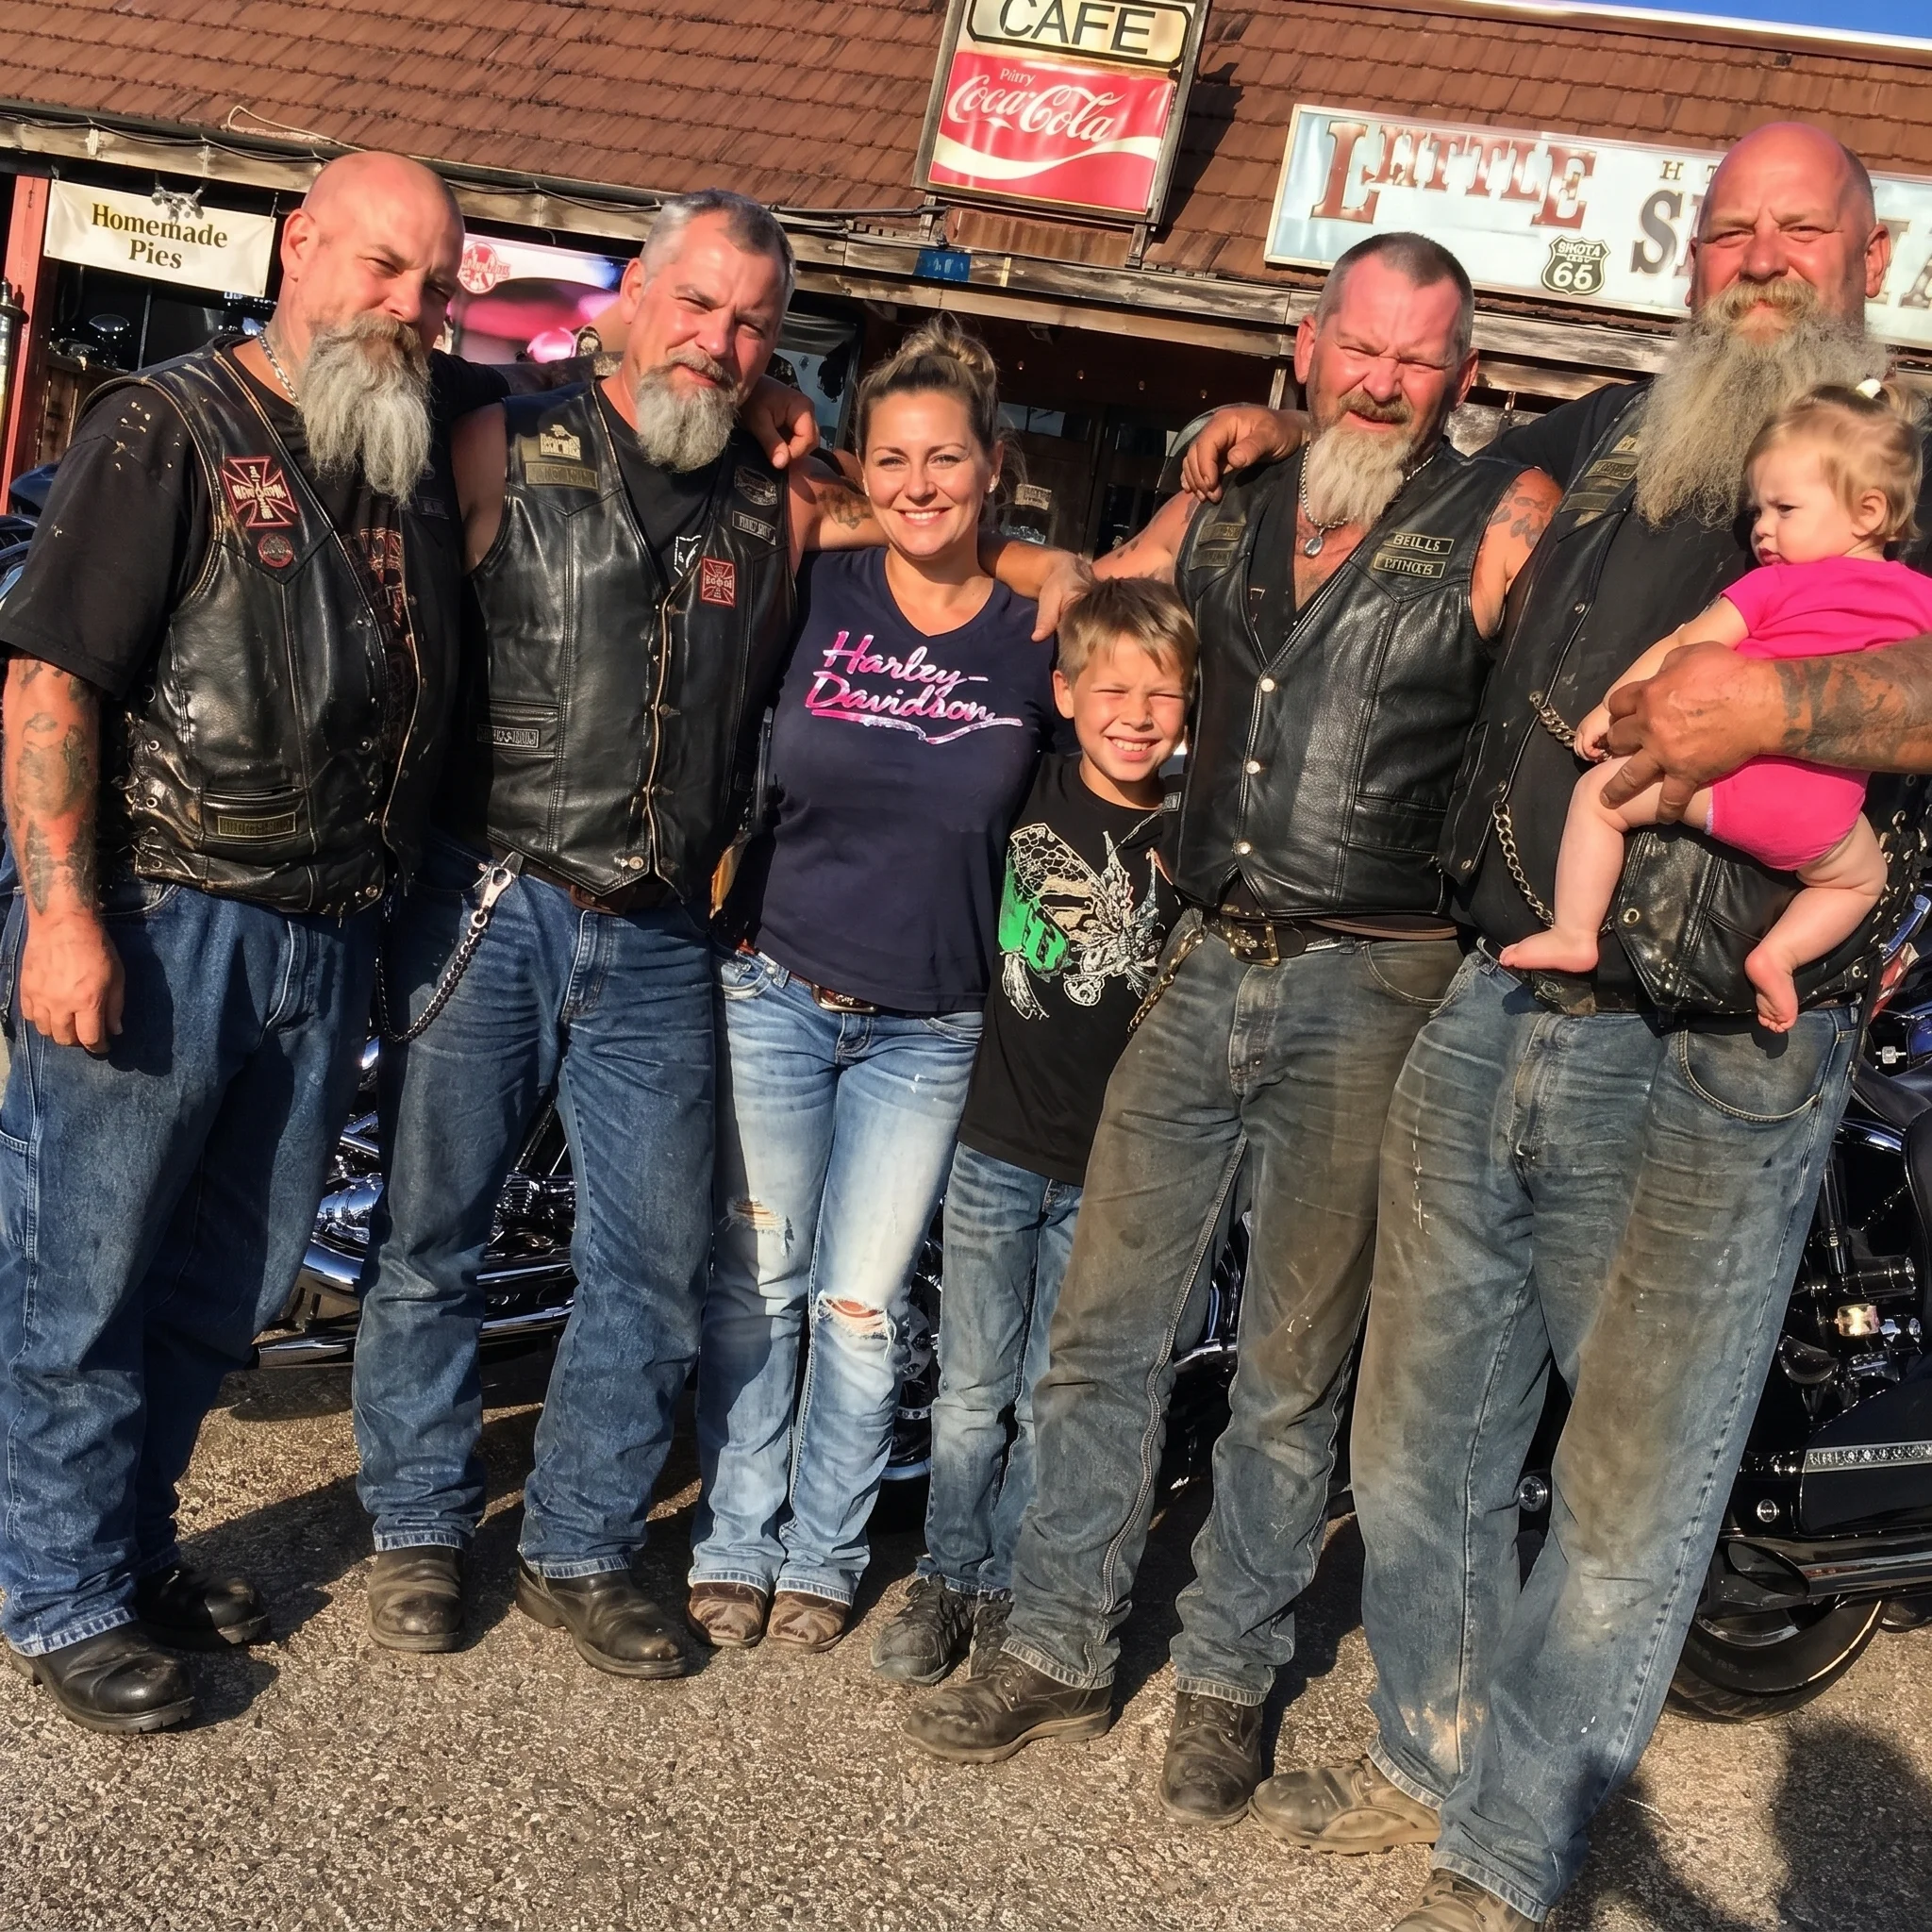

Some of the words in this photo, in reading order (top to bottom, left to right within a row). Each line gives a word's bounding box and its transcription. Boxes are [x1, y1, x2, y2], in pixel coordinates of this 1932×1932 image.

[999, 0, 1156, 55] CAFE
[92, 202, 228, 248] Homemade
[128, 239, 183, 270] Pies
[805, 671, 996, 722] Davidson
